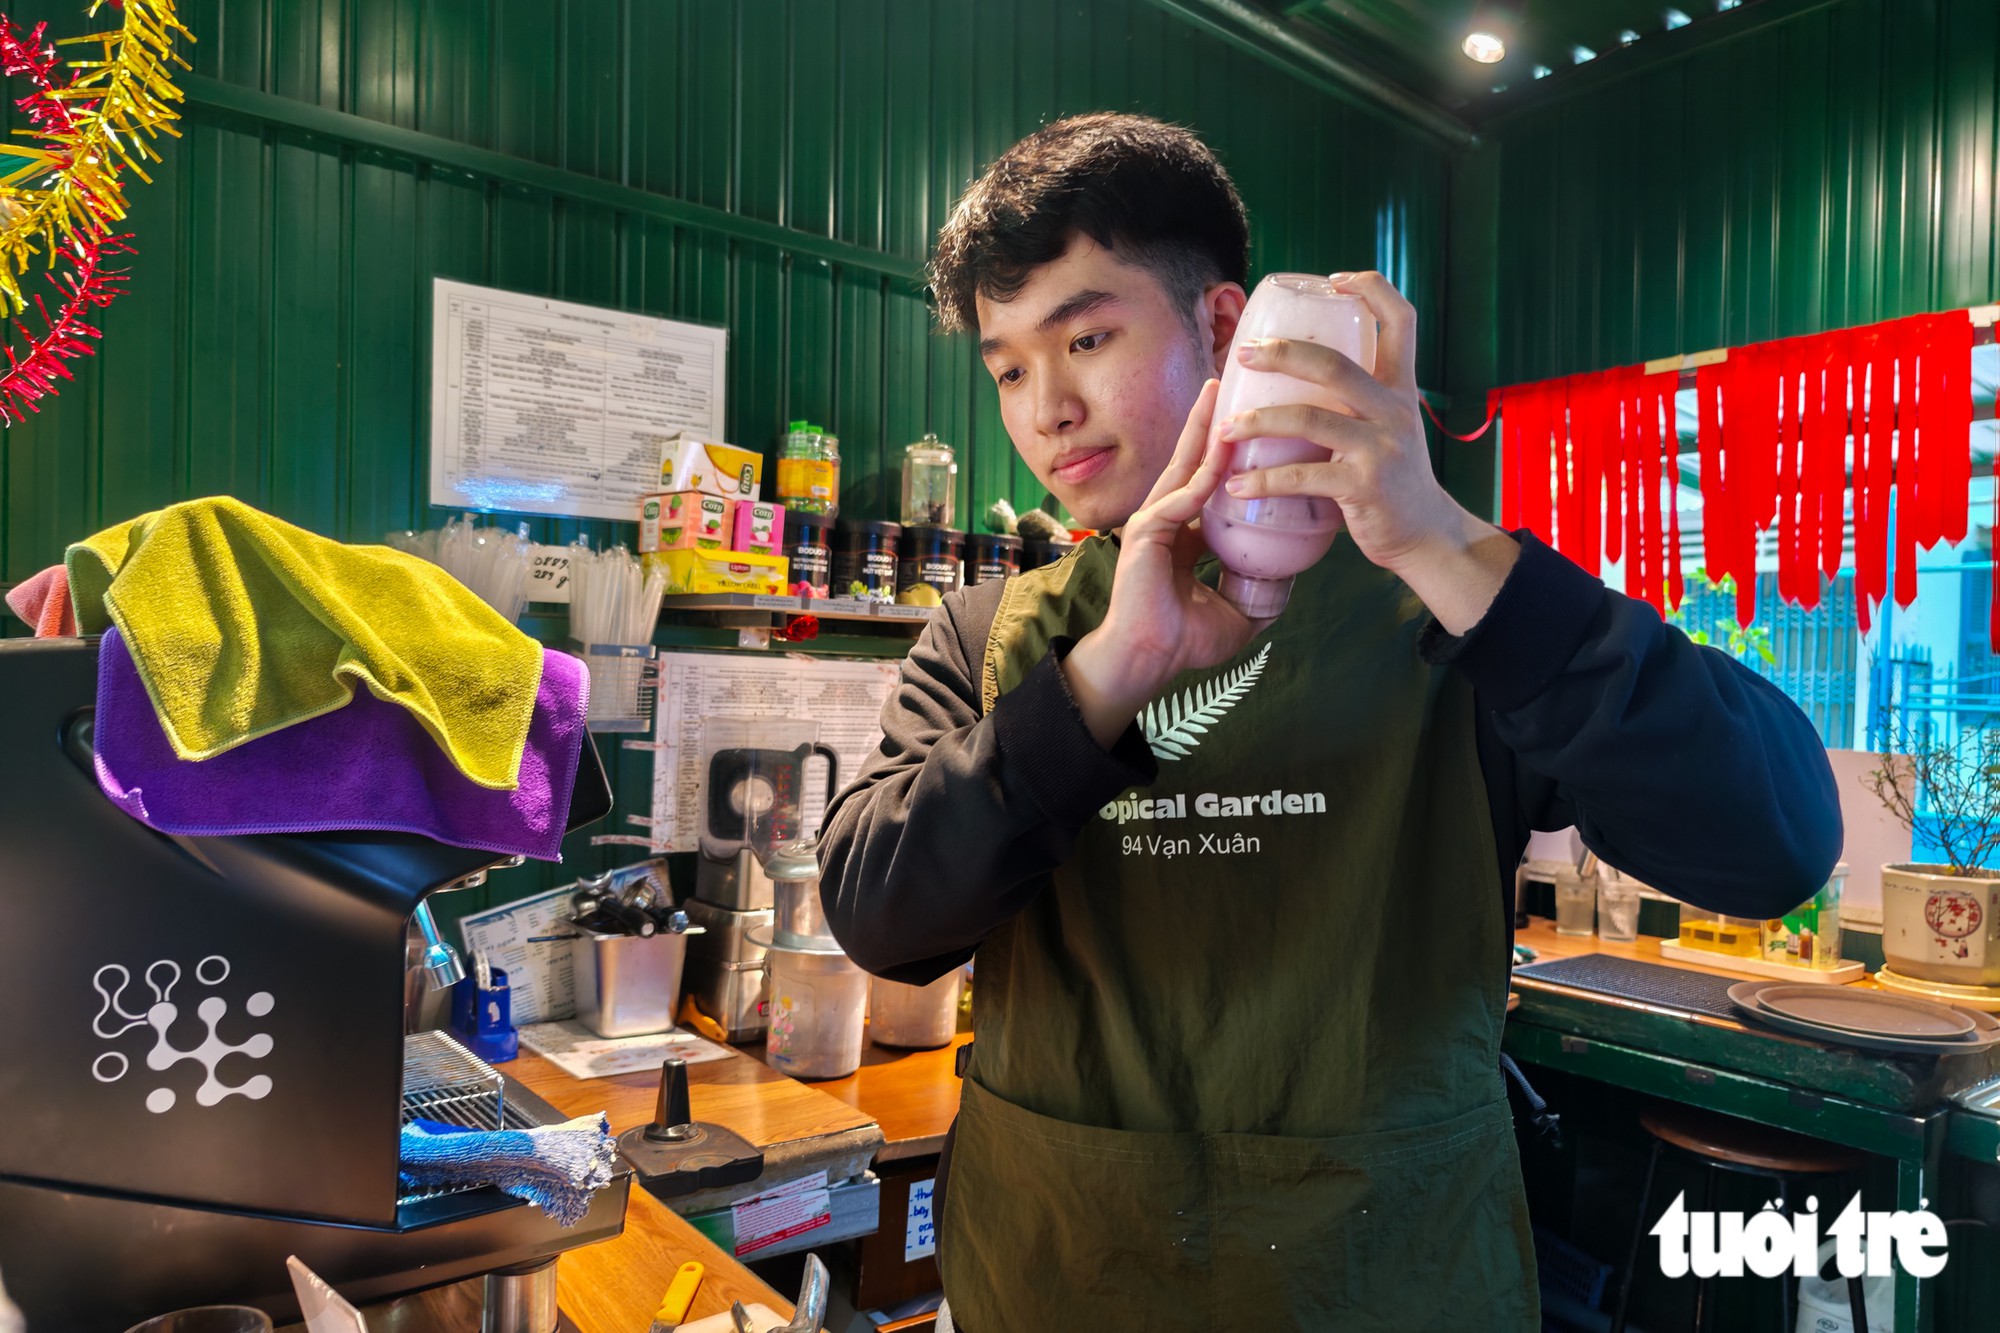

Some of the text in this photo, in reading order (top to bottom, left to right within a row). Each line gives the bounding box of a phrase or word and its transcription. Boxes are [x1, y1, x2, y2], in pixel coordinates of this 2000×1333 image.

[742, 466, 753, 493] Cozy
[702, 500, 723, 512] Cozy
[753, 510, 774, 519] Cozy
[1099, 790, 1326, 824] opical Garden
[1122, 833, 1260, 859] 94 Vạn Xuân
